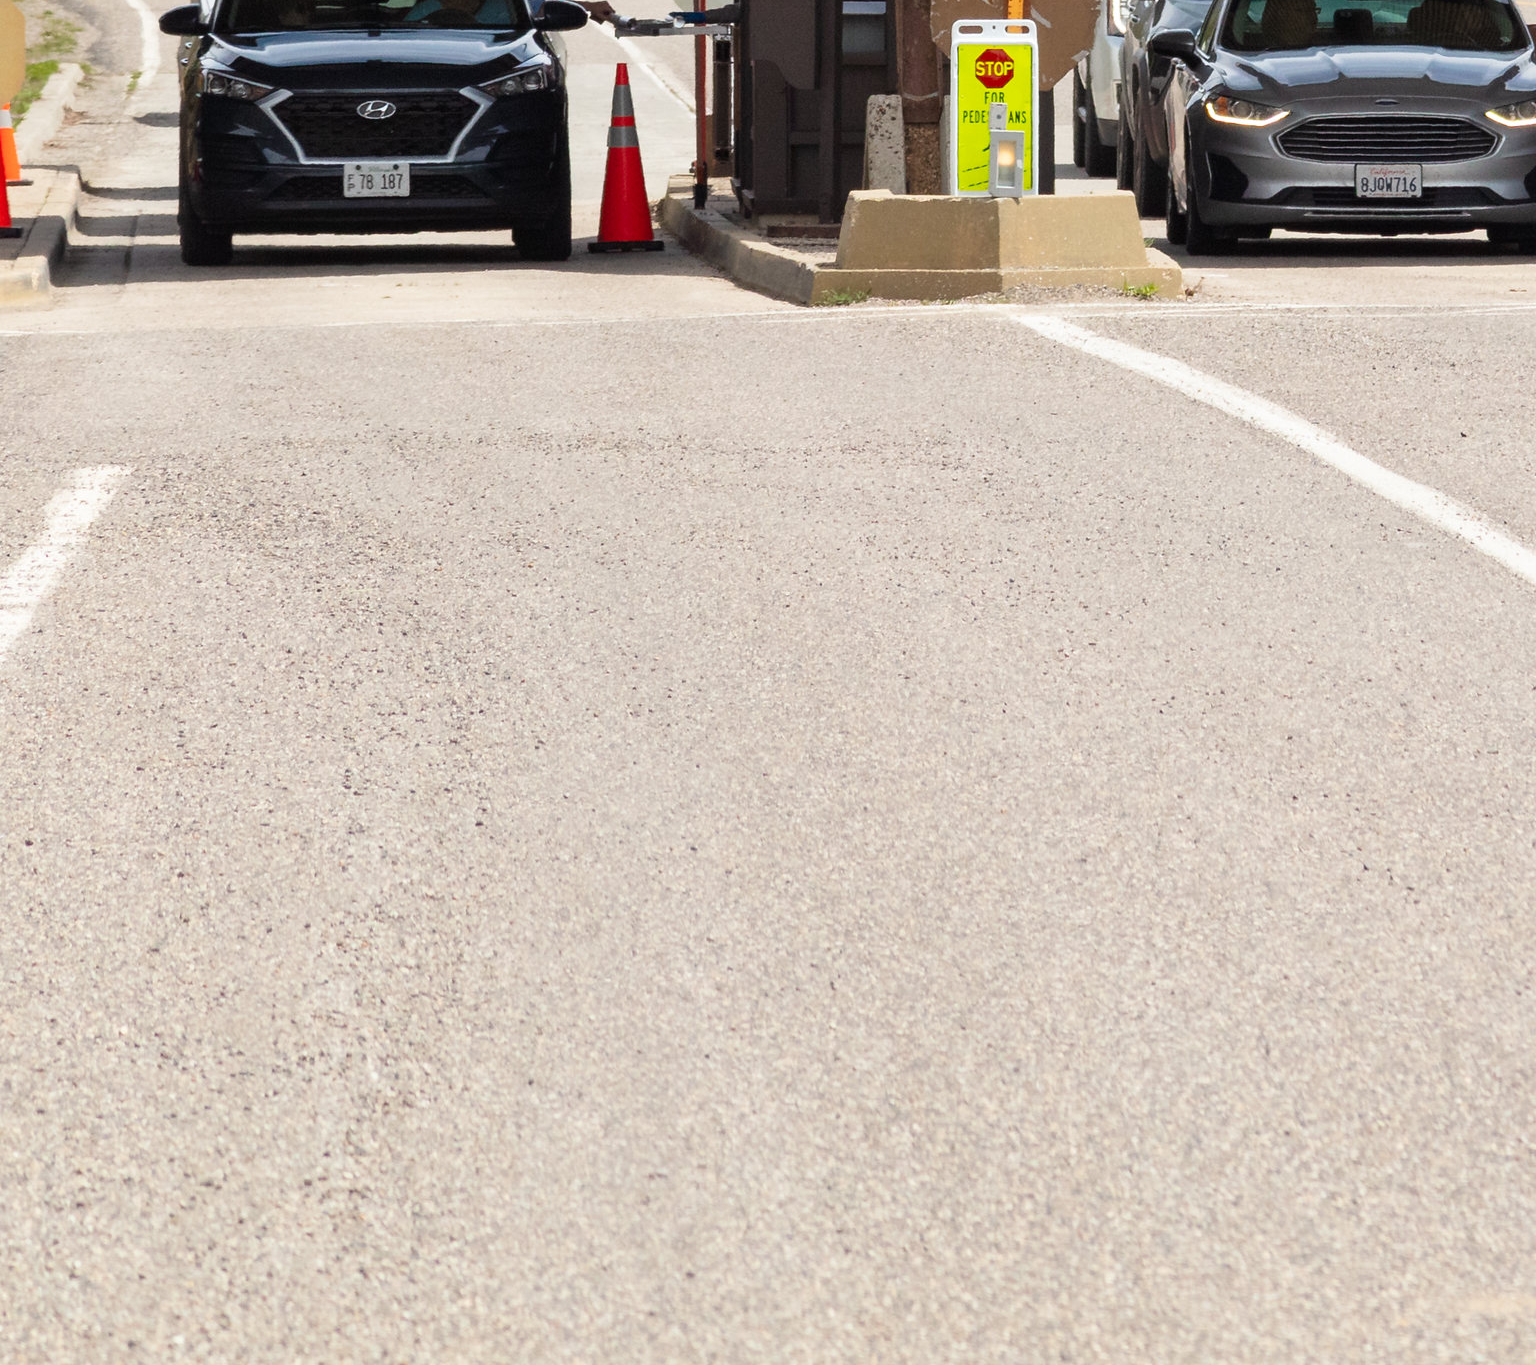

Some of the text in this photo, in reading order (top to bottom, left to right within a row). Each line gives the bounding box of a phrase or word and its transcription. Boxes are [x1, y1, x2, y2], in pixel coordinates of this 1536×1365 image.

[975, 61, 1014, 77] STOP
[984, 91, 1005, 105] FOR
[962, 110, 1027, 124] PEDEANS
[359, 173, 404, 190] 78 187
